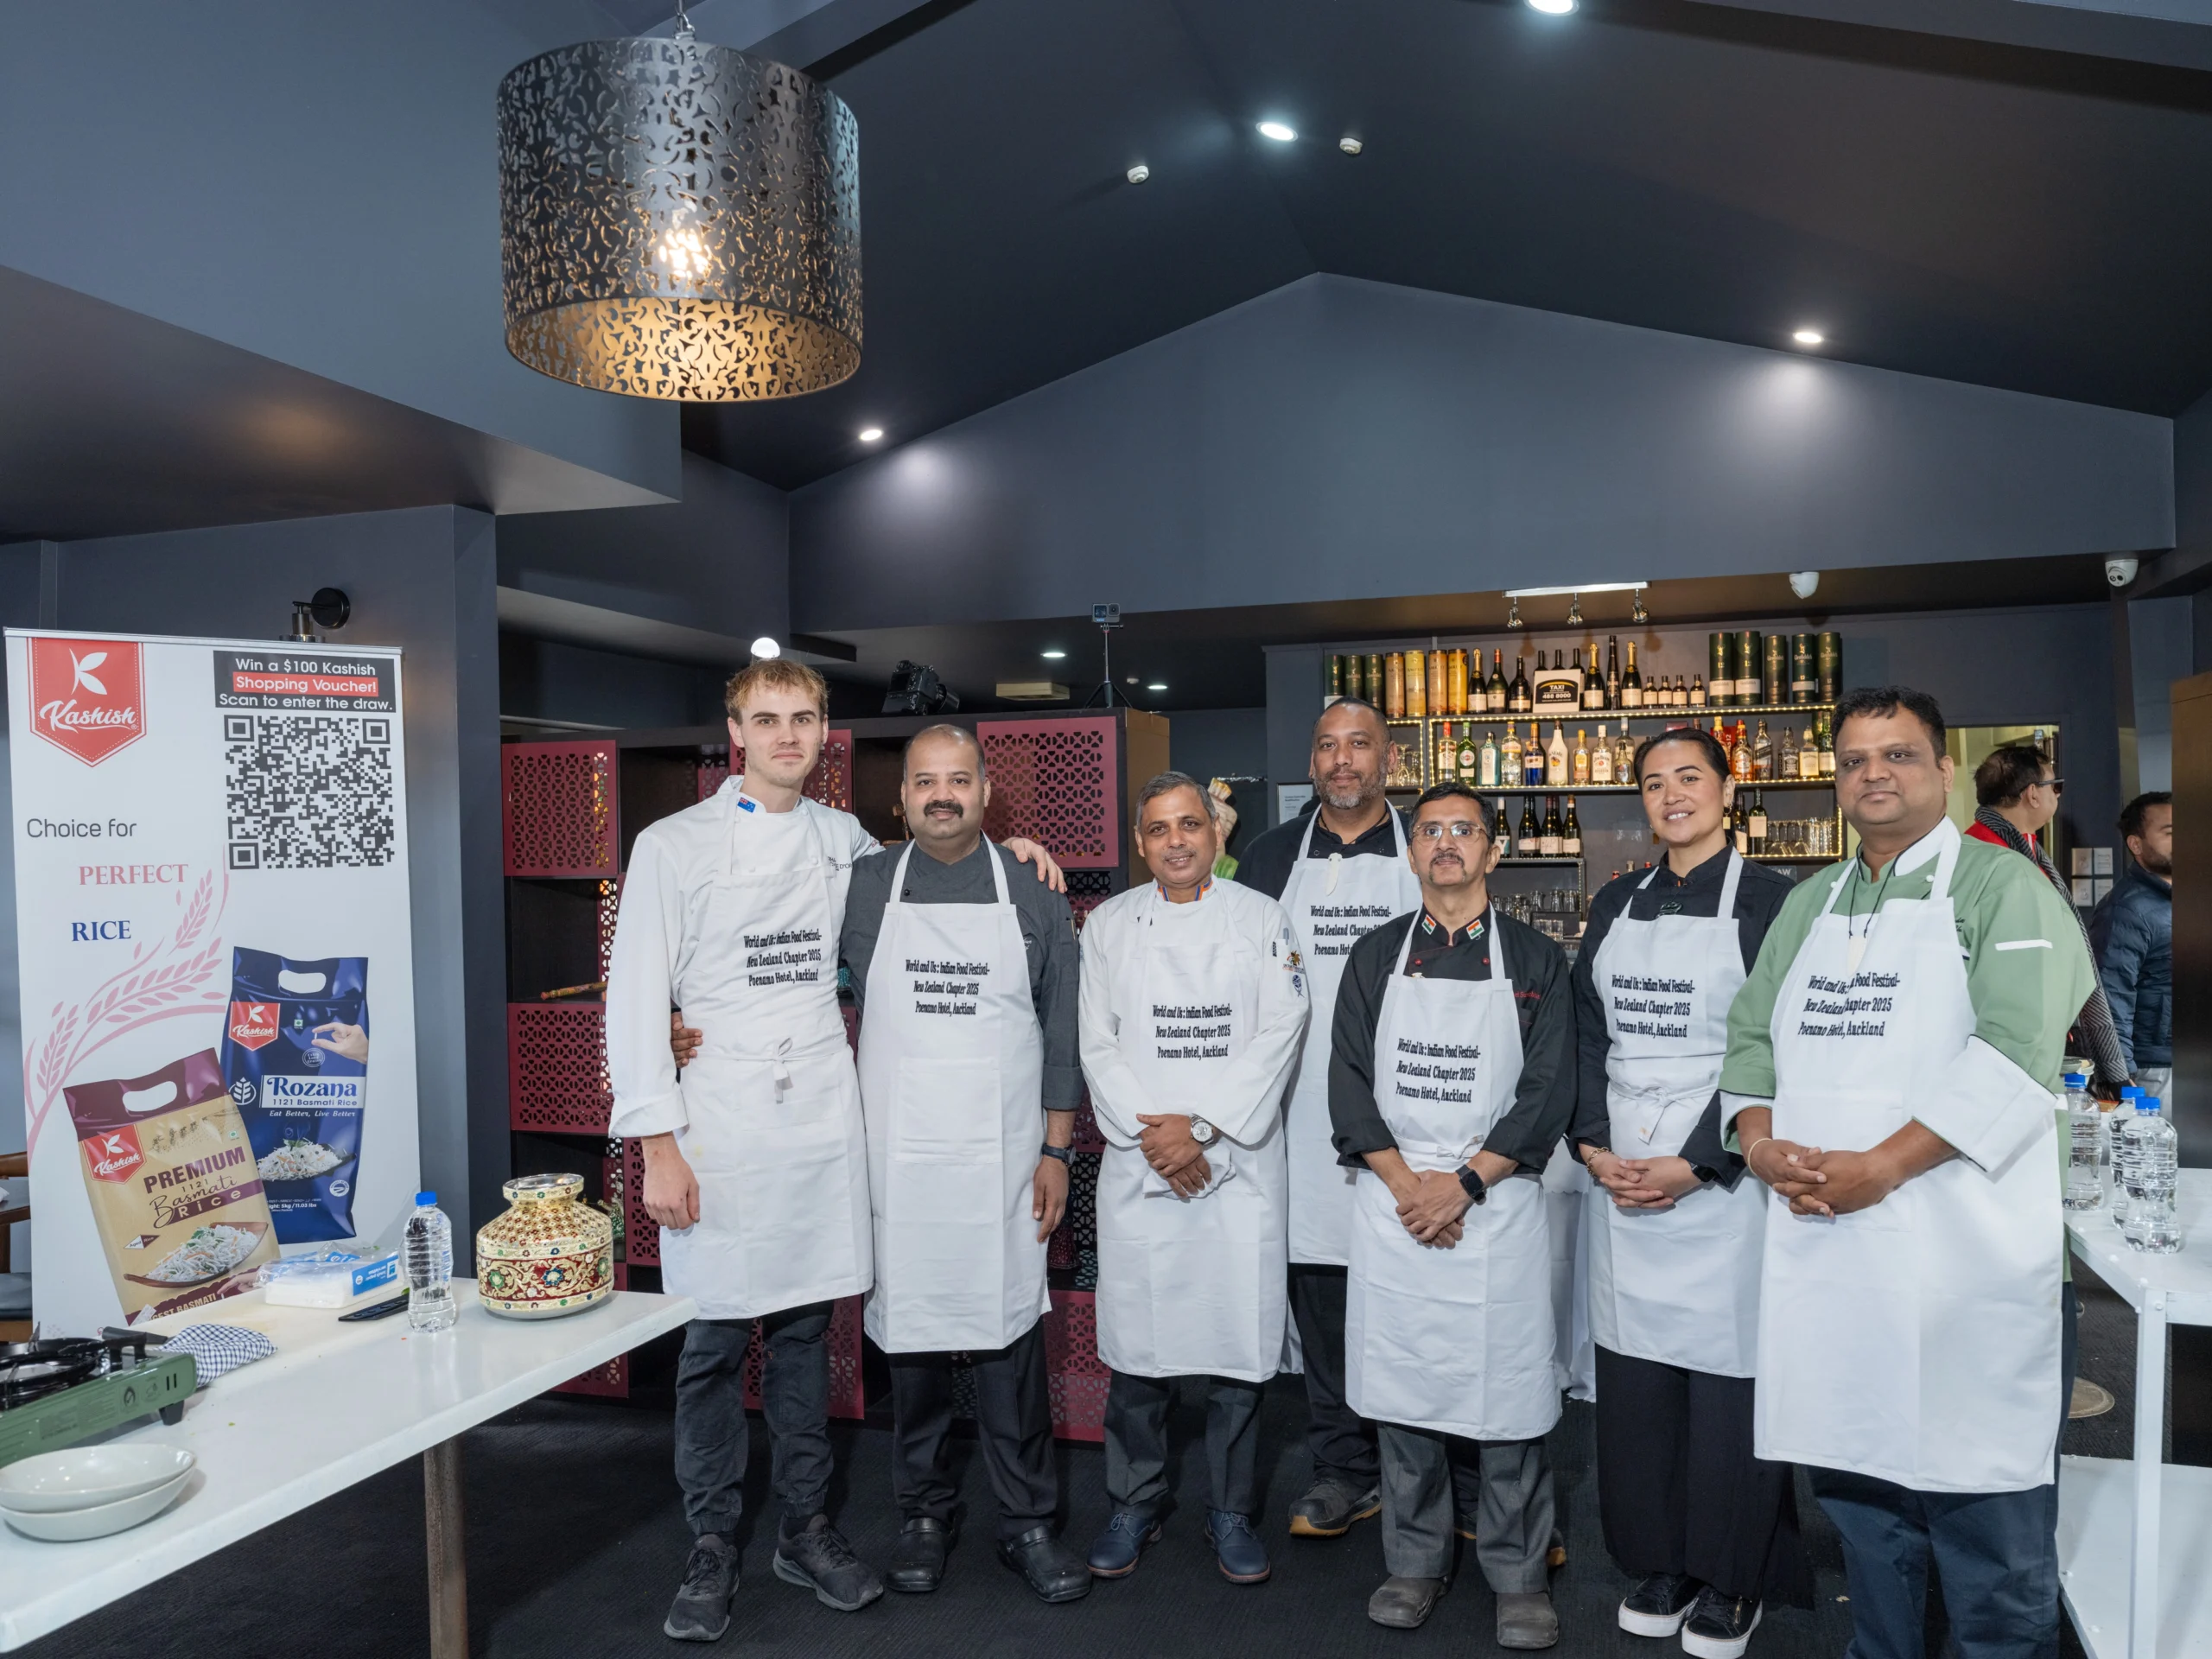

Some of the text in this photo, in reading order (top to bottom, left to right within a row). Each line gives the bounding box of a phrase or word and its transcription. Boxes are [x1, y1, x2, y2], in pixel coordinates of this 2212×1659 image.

[235, 658, 376, 676] Win a $100 Kashish
[236, 676, 377, 693] Shopping Voucher!
[219, 693, 393, 710] Scan to enter the draw.
[39, 699, 137, 734] Kashish
[27, 818, 137, 838] Choice for
[79, 863, 189, 886] PERFECT
[1311, 906, 1325, 917] World
[1325, 907, 1335, 917] and
[1359, 906, 1371, 918] Food
[71, 920, 131, 942] RICE
[744, 935, 760, 949] World
[760, 935, 770, 948] and
[791, 930, 803, 944] Food
[1313, 925, 1325, 937] New
[1325, 925, 1349, 937] Zealand
[747, 949, 822, 969] New Zealand Chapter 2025
[1314, 944, 1339, 956] Poenamo
[906, 959, 920, 973] World
[920, 961, 930, 974] and
[957, 963, 969, 976] Food
[749, 969, 819, 987] Poenamo Hotel, Auckland
[1611, 975, 1624, 989] World
[1624, 976, 1633, 990] and
[1658, 979, 1671, 993] Food
[1808, 976, 1827, 990] World
[1825, 981, 1840, 993] and
[1855, 972, 1872, 988] Food
[913, 981, 980, 998] New Zealand Chapter 2025
[915, 1001, 977, 1018] Poenamo Hotel, Auckland
[1153, 1005, 1167, 1018] World
[1166, 1007, 1177, 1019] and
[1202, 1006, 1214, 1019] Food
[1614, 997, 1691, 1019] New Zealand Chapter 2025
[1803, 999, 1818, 1013] New
[1872, 997, 1893, 1013] 2025
[232, 1024, 275, 1039] Kashish
[1155, 1024, 1231, 1041] New Zealand Chapter 2025
[1637, 1022, 1656, 1039] Hotel,
[1656, 1023, 1688, 1038] Auckland
[1798, 1021, 1827, 1036] Poenamo
[1847, 1021, 1885, 1037] Auckland
[1158, 1045, 1229, 1061] Poenamo Hotel, Auckland
[1397, 1039, 1411, 1053] World
[1410, 1042, 1419, 1055] and
[1445, 1046, 1458, 1058] Food
[1396, 1060, 1476, 1084] New Zealand Chapter 2025
[266, 1077, 357, 1097] Rozana
[1396, 1082, 1472, 1103] Poenamo Hotel, Auckland
[94, 1153, 141, 1176] Kashish
[143, 1147, 246, 1194] PREMIUM
[181, 1179, 209, 1192] 1121
[149, 1175, 237, 1228] Basmati
[176, 1293, 217, 1313] BASMATI
